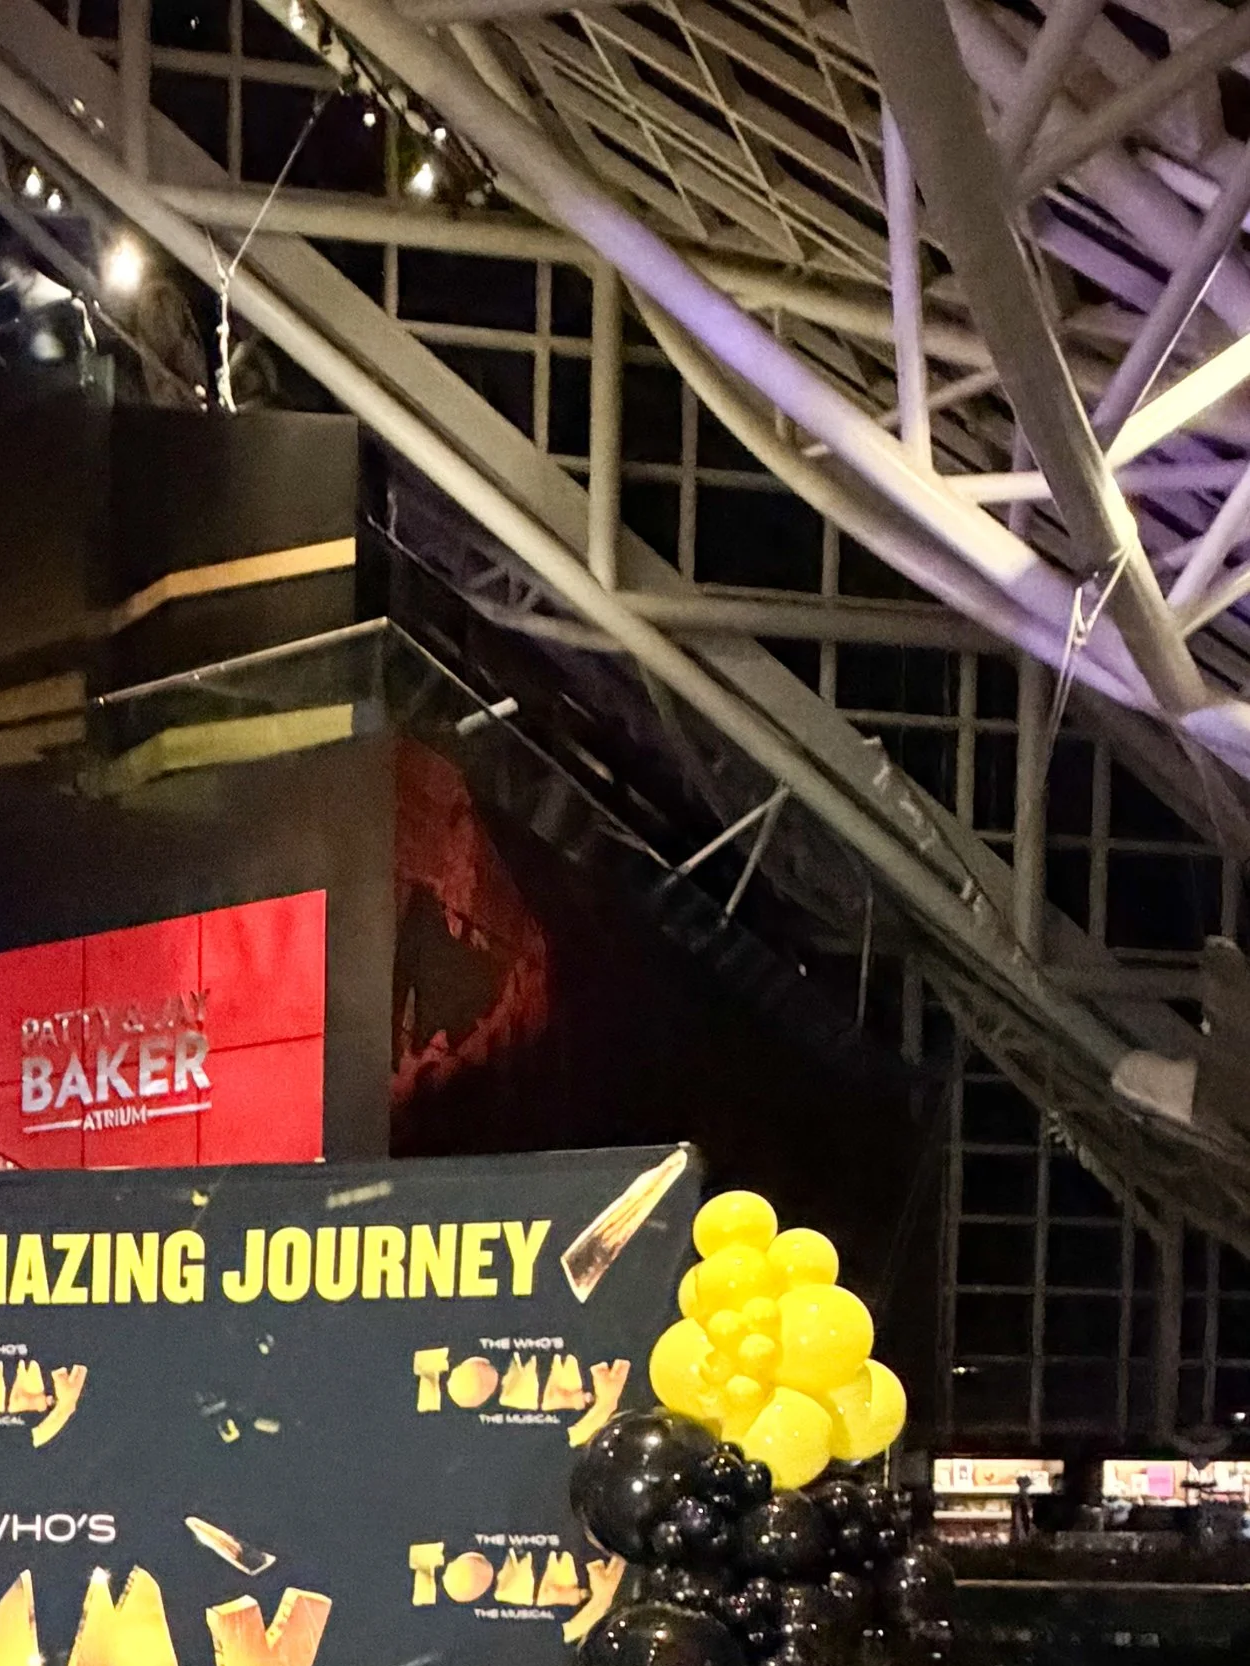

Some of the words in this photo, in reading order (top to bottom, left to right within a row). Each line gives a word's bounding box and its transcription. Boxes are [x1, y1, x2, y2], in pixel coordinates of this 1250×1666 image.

[21, 1030, 212, 1113] BAKER
[82, 1105, 147, 1131] ATRIUM
[222, 1220, 552, 1302] JOURNEY
[480, 1337, 510, 1350] THE
[513, 1337, 564, 1350] WHO'S
[479, 1414, 504, 1424] THE
[475, 1534, 505, 1546] THE
[508, 1534, 560, 1547] WHO'S
